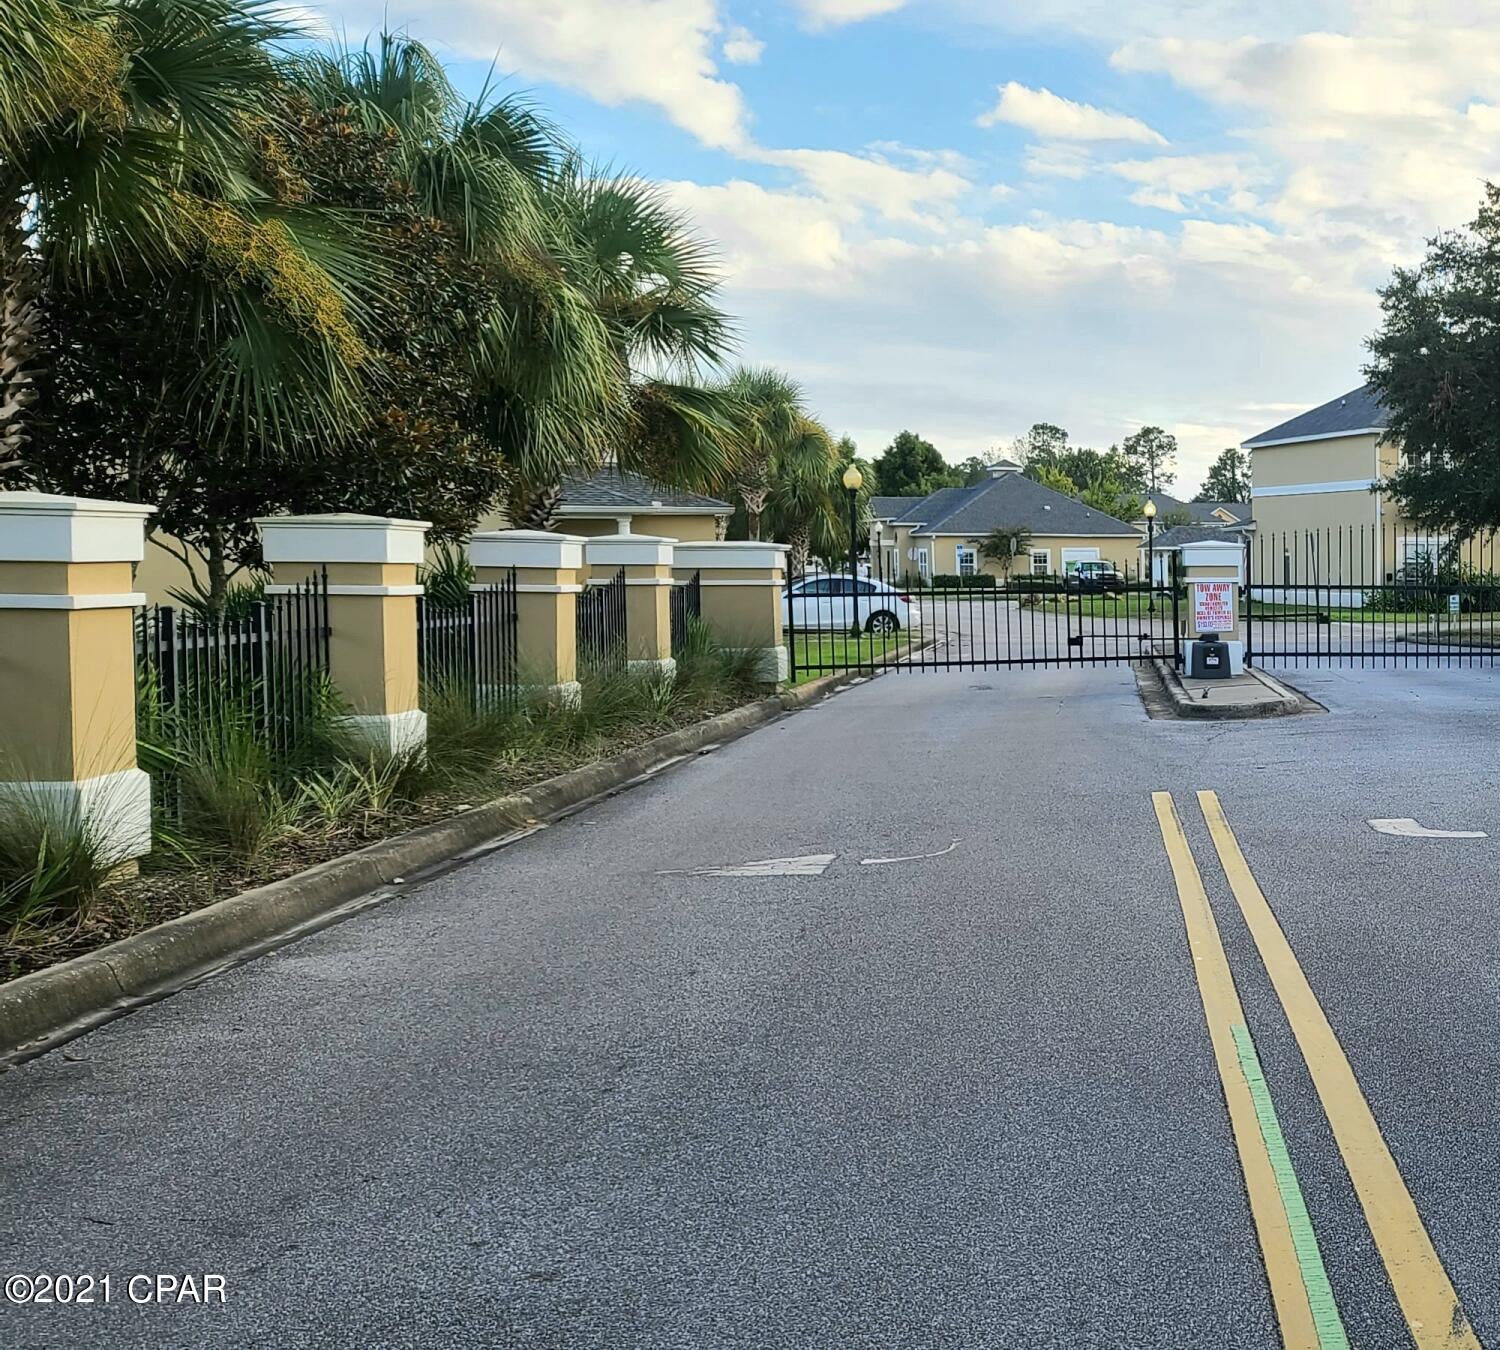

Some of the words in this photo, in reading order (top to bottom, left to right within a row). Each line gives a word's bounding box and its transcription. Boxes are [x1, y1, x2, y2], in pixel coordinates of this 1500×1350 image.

[1196, 583, 1211, 592] TOW
[1212, 583, 1231, 592] AWAY
[1205, 592, 1222, 601] ZONE
